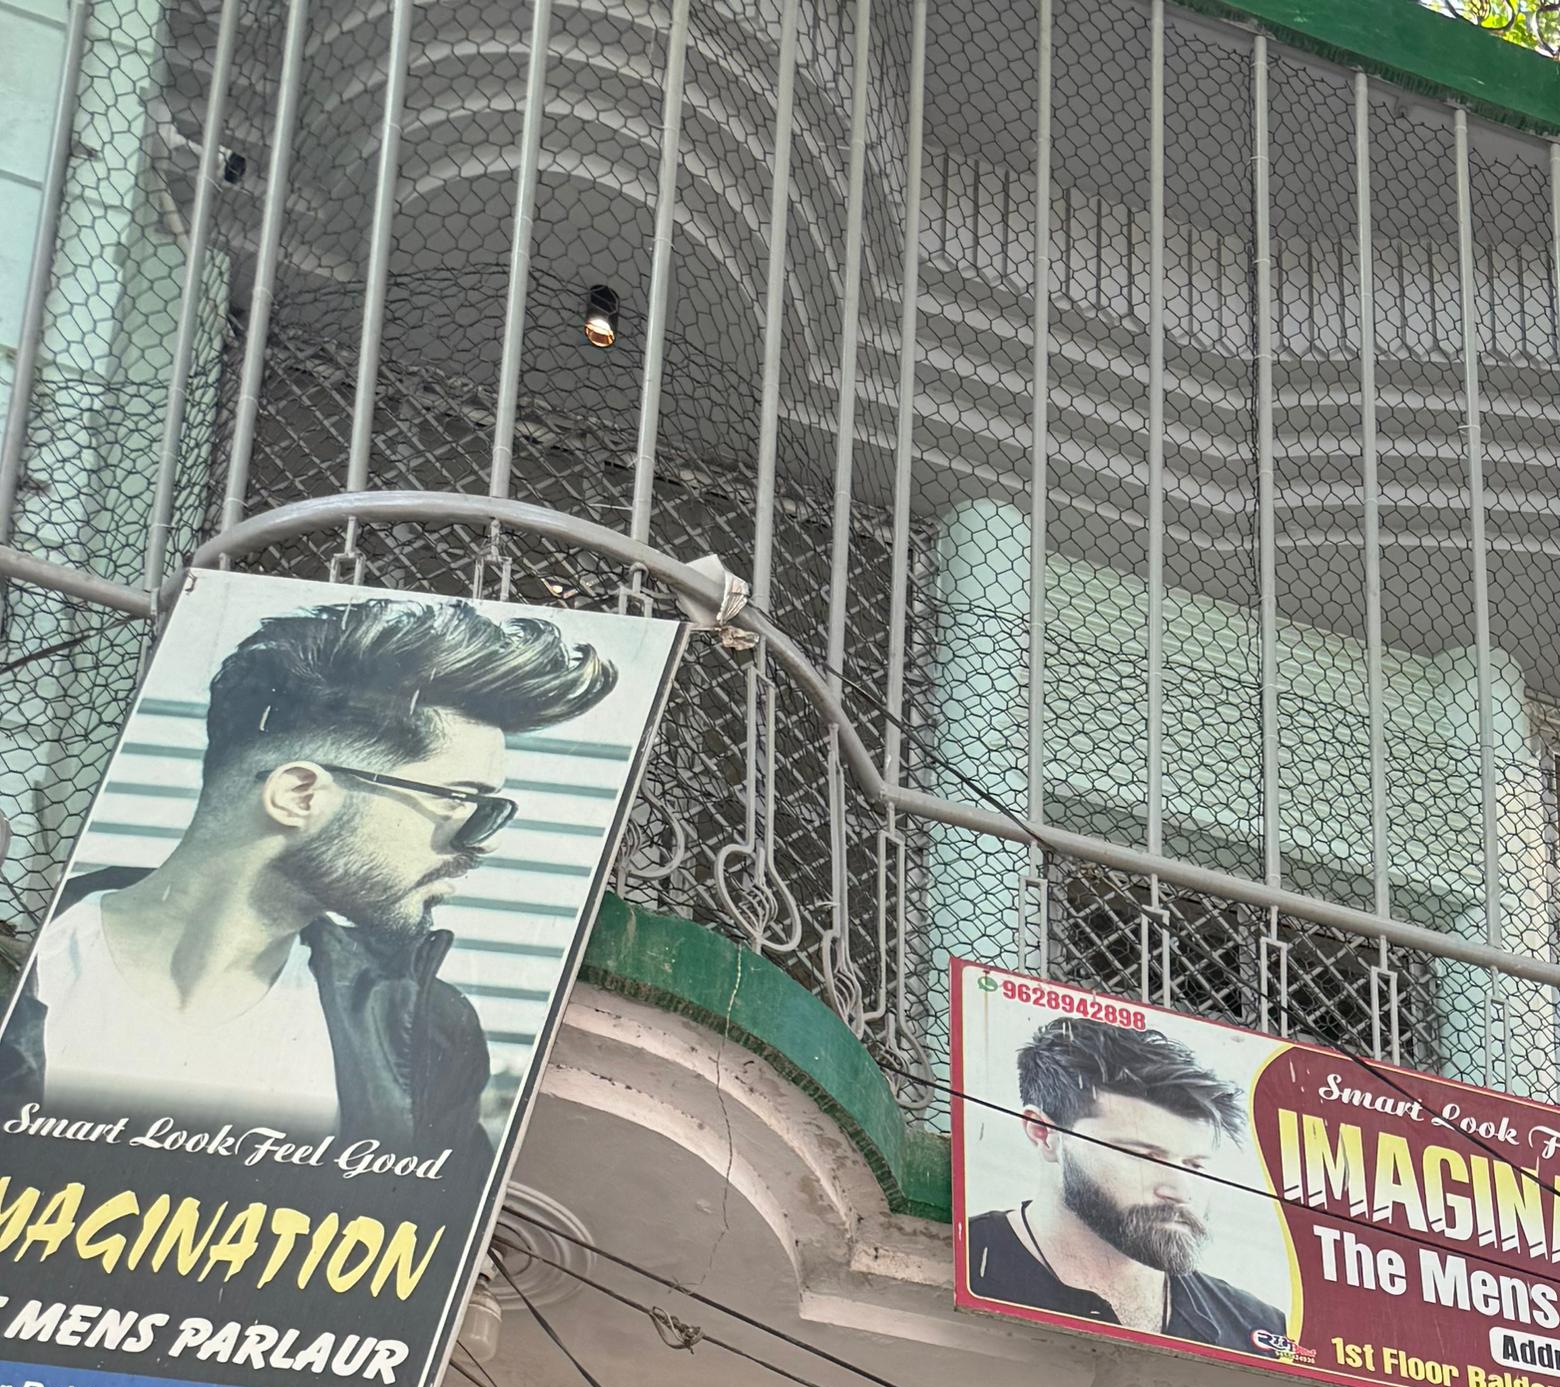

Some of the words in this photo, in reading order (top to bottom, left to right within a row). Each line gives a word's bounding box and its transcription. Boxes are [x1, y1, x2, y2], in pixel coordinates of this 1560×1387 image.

[1002, 979, 1147, 1033] 9628942898
[3, 1102, 130, 1144] Smart
[130, 1116, 238, 1157] Look
[236, 1126, 326, 1168] Feel
[333, 1138, 453, 1180] Good
[1319, 1073, 1425, 1121] Smart
[1431, 1100, 1520, 1146] Look
[1312, 1225, 1407, 1297] The
[1420, 1249, 1558, 1332] Mens
[4, 1299, 170, 1354] MENS
[168, 1317, 410, 1386] PARLAUR
[1331, 1336, 1376, 1373] 1st
[1382, 1346, 1459, 1387] Floor
